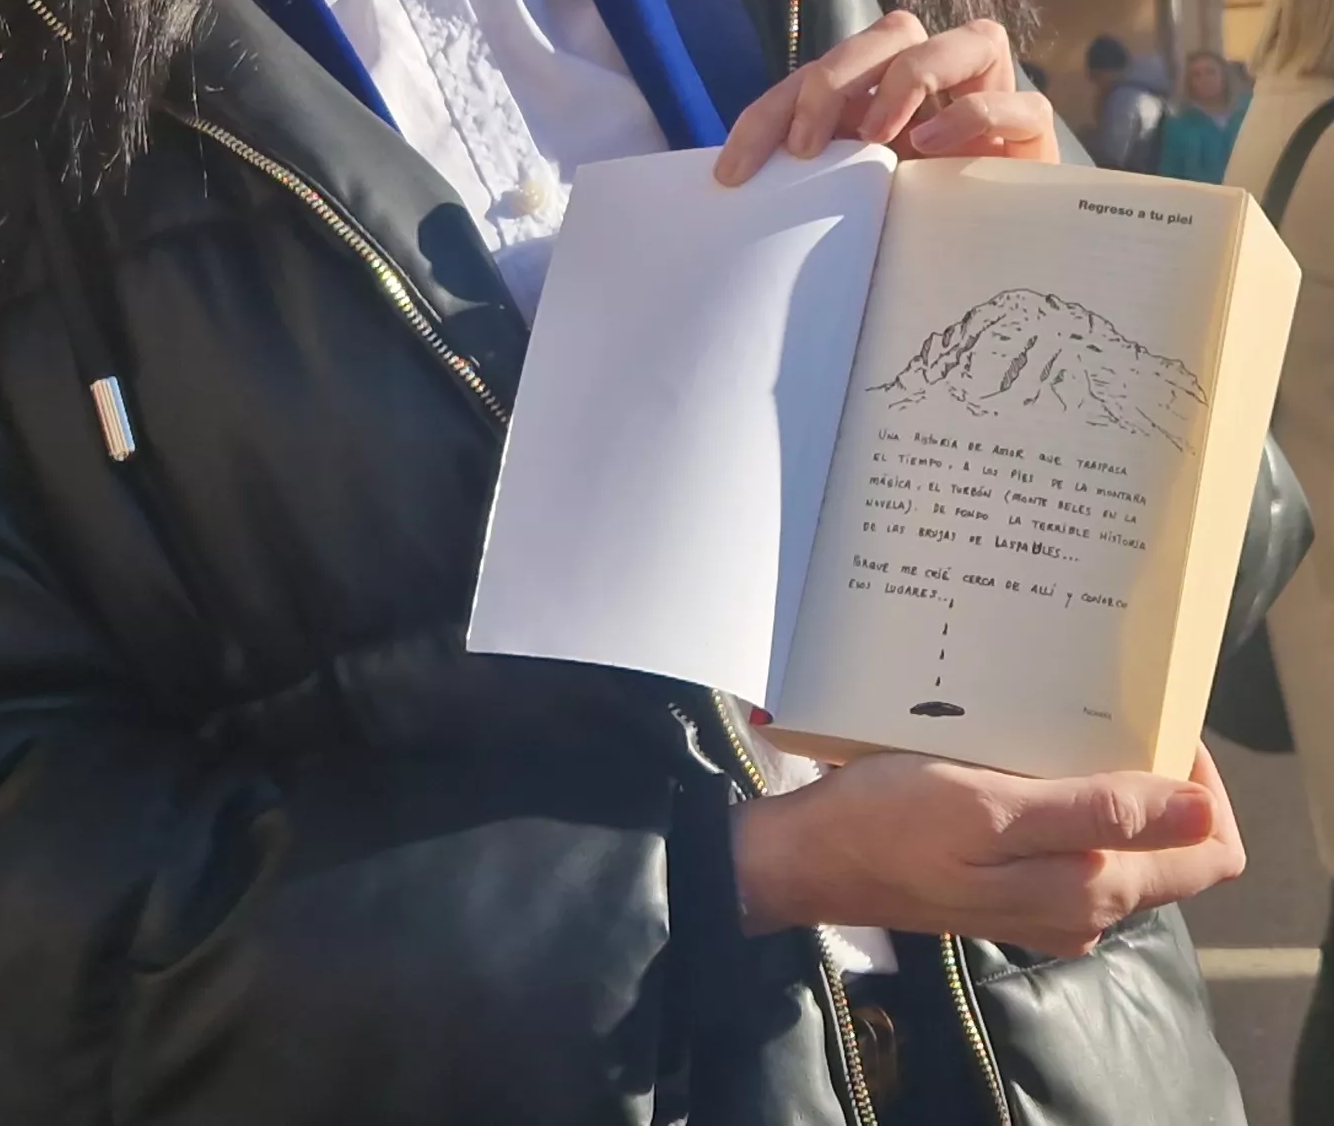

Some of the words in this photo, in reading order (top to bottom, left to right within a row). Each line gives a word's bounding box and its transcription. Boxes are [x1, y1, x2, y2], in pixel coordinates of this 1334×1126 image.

[1078, 199, 1134, 216] Regreso
[1137, 209, 1146, 219] a
[1150, 210, 1164, 222] tu
[1167, 213, 1193, 225] piel
[968, 441, 983, 452] DE
[873, 452, 887, 462] EL
[963, 460, 970, 472] A
[1051, 478, 1064, 490] DE
[1075, 482, 1088, 493] LA
[928, 481, 941, 493] EL
[1102, 509, 1117, 519] EN
[1124, 514, 1137, 524] LA
[933, 503, 946, 514] DE
[955, 507, 989, 521] FONDO
[1008, 515, 1022, 525] LA
[863, 522, 876, 532] DE
[886, 524, 905, 535] LAS
[918, 527, 956, 543] BRUJAS
[969, 535, 982, 545] DE
[901, 565, 918, 576] ME
[962, 574, 995, 587] CERCA
[1005, 579, 1020, 591] DE
